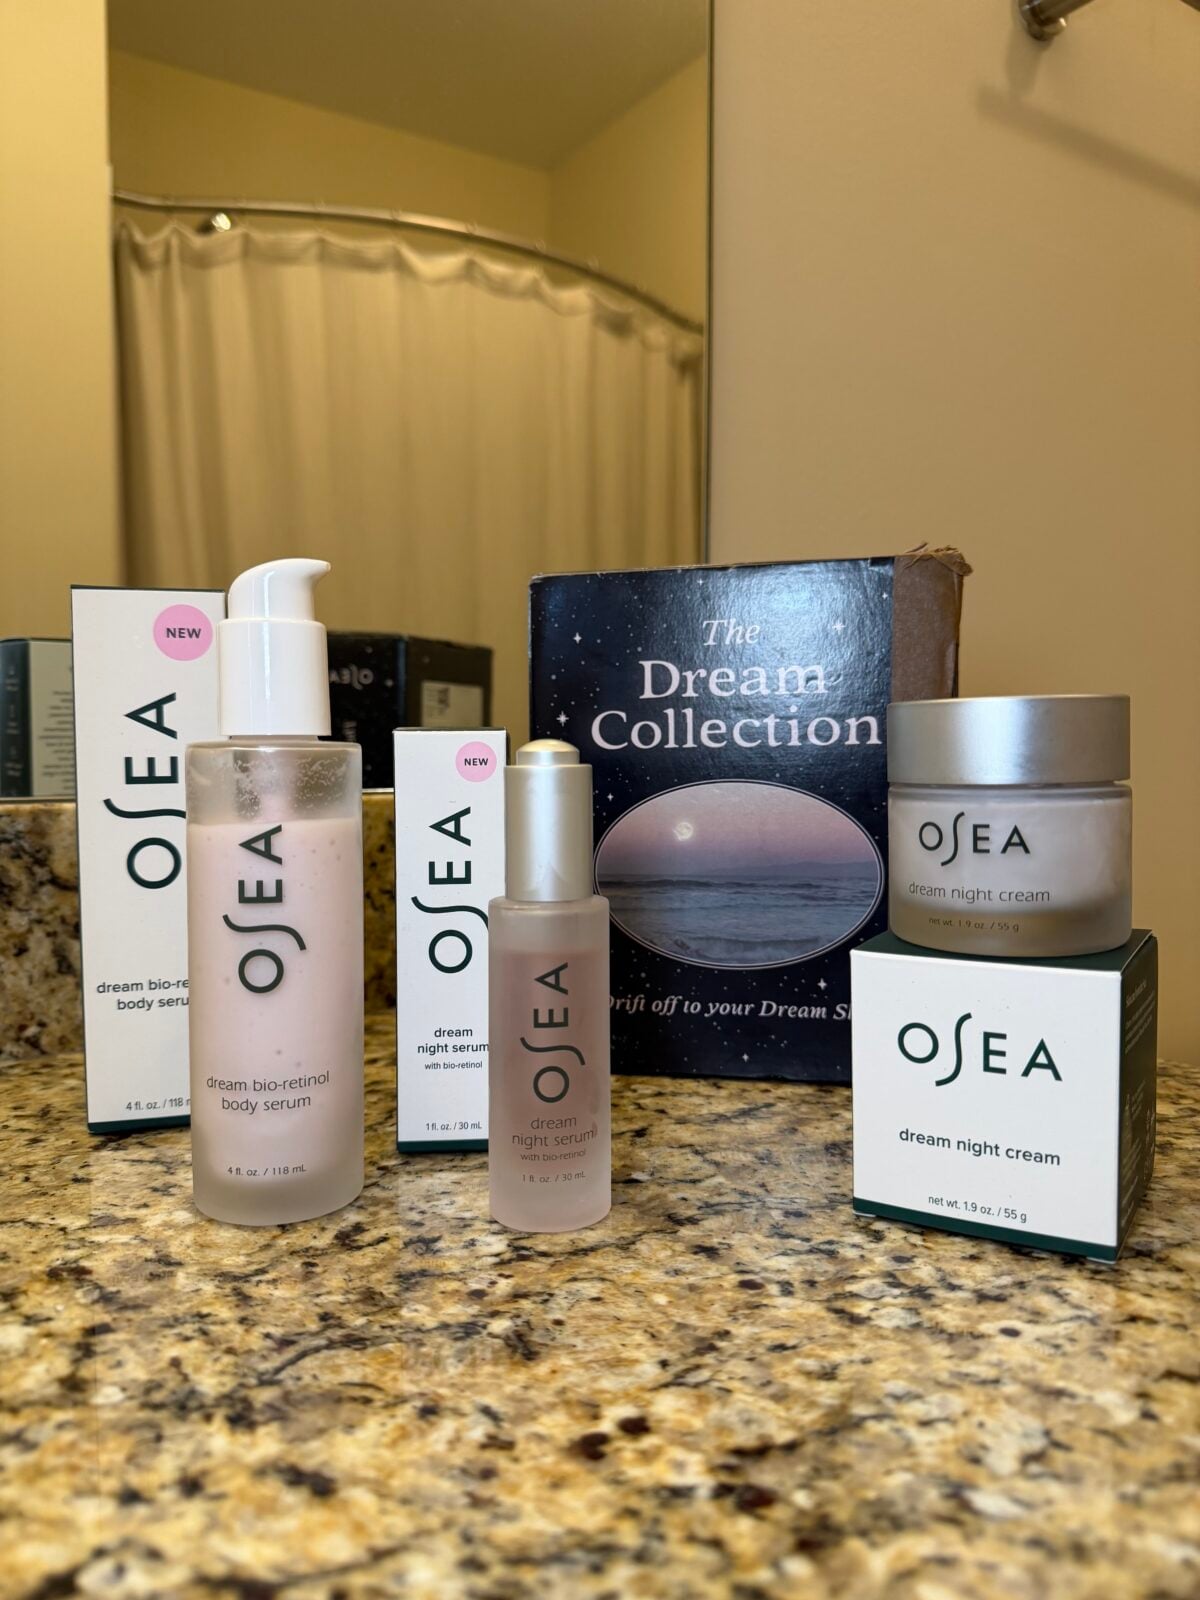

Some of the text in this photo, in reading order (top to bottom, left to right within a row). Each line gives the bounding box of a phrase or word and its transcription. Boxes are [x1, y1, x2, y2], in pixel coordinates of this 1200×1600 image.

[166, 627, 202, 639] NEW
[702, 619, 760, 646] The
[639, 660, 829, 699] Dream
[590, 705, 882, 750] Collection
[464, 757, 489, 767] NEW
[103, 692, 186, 889] OSEA
[918, 811, 1031, 867] OSEA
[411, 806, 489, 974] OSEA
[908, 881, 1050, 904] dream night cream
[222, 824, 307, 994] OSEA
[928, 917, 940, 926] net
[998, 922, 1010, 931] 55
[1012, 924, 1019, 933] g
[96, 982, 144, 994] dream
[117, 997, 155, 1012] body
[651, 996, 683, 1016] off
[683, 1000, 701, 1014] to
[704, 1002, 755, 1018] your
[758, 1000, 828, 1019] Dream
[434, 1027, 473, 1038] dream
[520, 962, 586, 1104] OSEA
[417, 1043, 489, 1056] night serum
[897, 1012, 1063, 1087] OSEA
[424, 1061, 483, 1070] with bio-retinol
[206, 1070, 330, 1092] dream bio-retinol
[126, 1101, 132, 1111] 4
[146, 1101, 160, 1110] oz.
[168, 1097, 184, 1108] 118
[222, 1096, 311, 1115] body serum
[440, 1123, 452, 1131] oz.
[458, 1121, 469, 1130] 30
[470, 1121, 482, 1130] mL
[530, 1117, 577, 1130] dream
[512, 1129, 594, 1150] night serum
[899, 1128, 1061, 1166] dream night cream
[520, 1149, 587, 1162] with bio-retinol
[227, 1166, 233, 1175] 4
[272, 1166, 290, 1176] 118
[292, 1164, 307, 1174] mL
[562, 1173, 573, 1182] 30
[574, 1171, 586, 1179] mL
[928, 1196, 944, 1207] net
[946, 1199, 961, 1210] wt.
[963, 1201, 978, 1212] 1.9
[980, 1205, 995, 1216] oz.
[1004, 1208, 1018, 1220] 55
[1020, 1212, 1027, 1224] g
